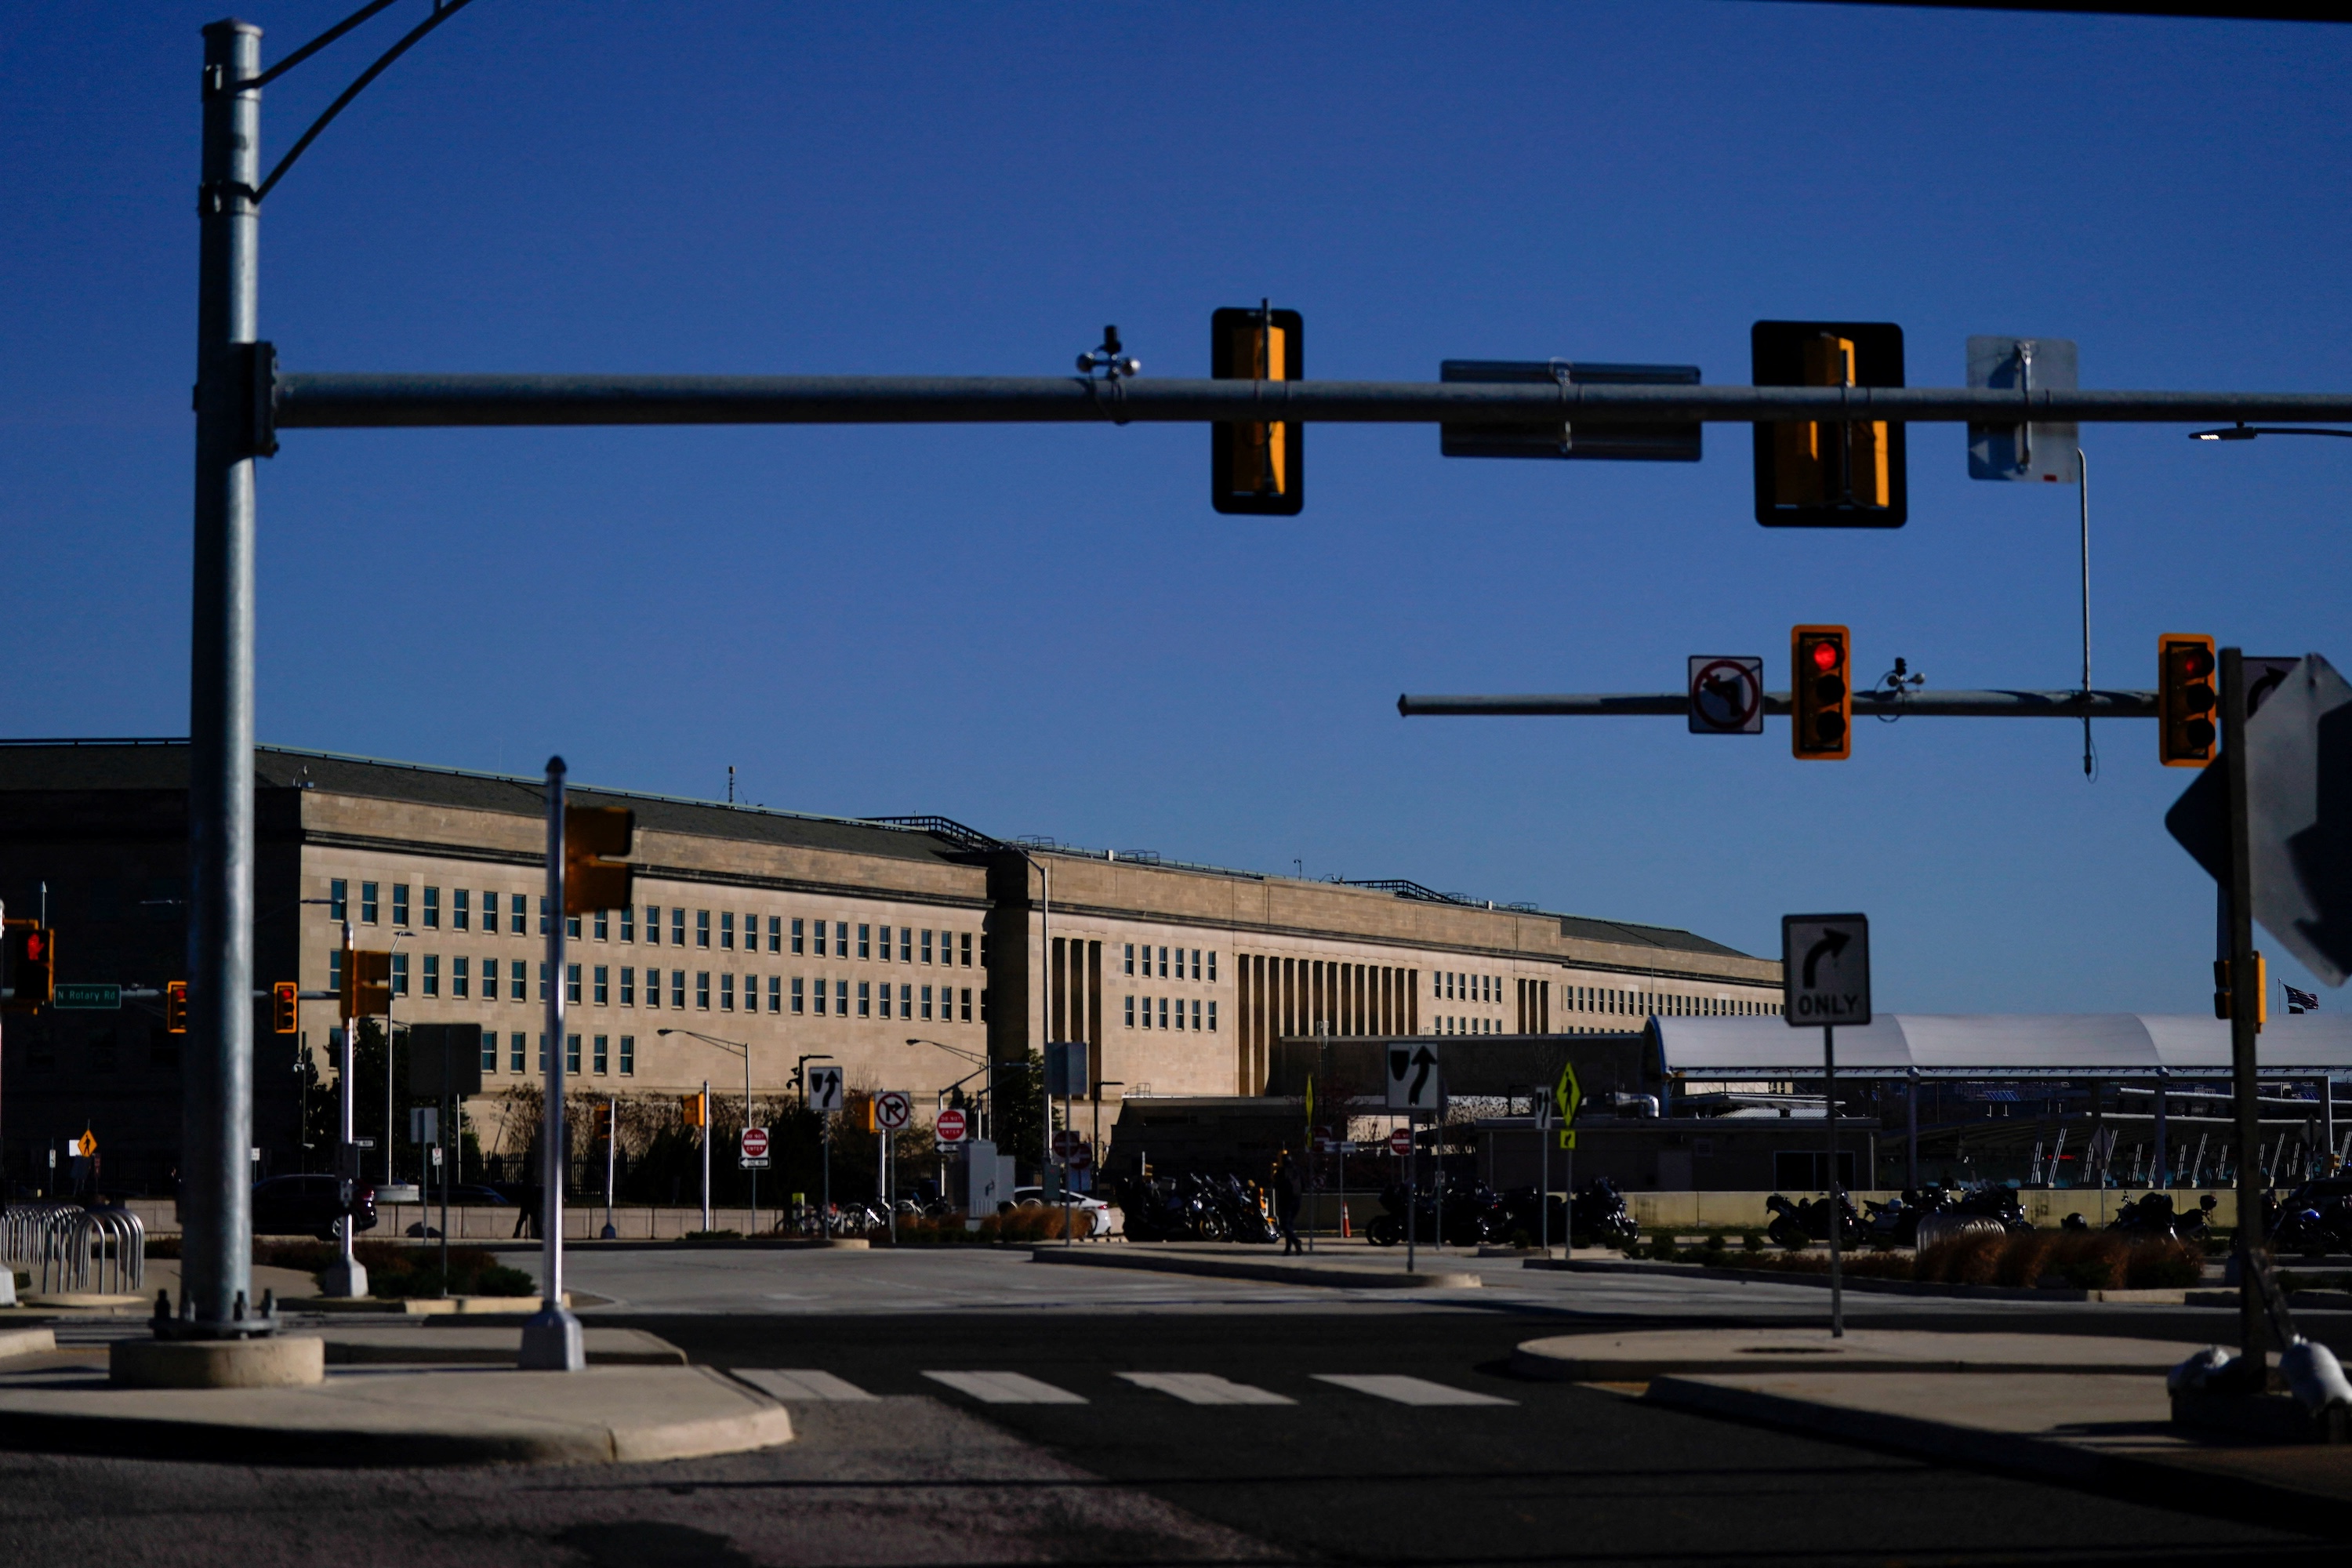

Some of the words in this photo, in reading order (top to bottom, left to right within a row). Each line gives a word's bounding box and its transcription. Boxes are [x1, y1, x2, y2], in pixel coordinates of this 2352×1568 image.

[58, 990, 64, 1000] N
[69, 990, 100, 1002] Rotary
[104, 990, 115, 1000] Rd
[1798, 994, 1859, 1015] ONLY
